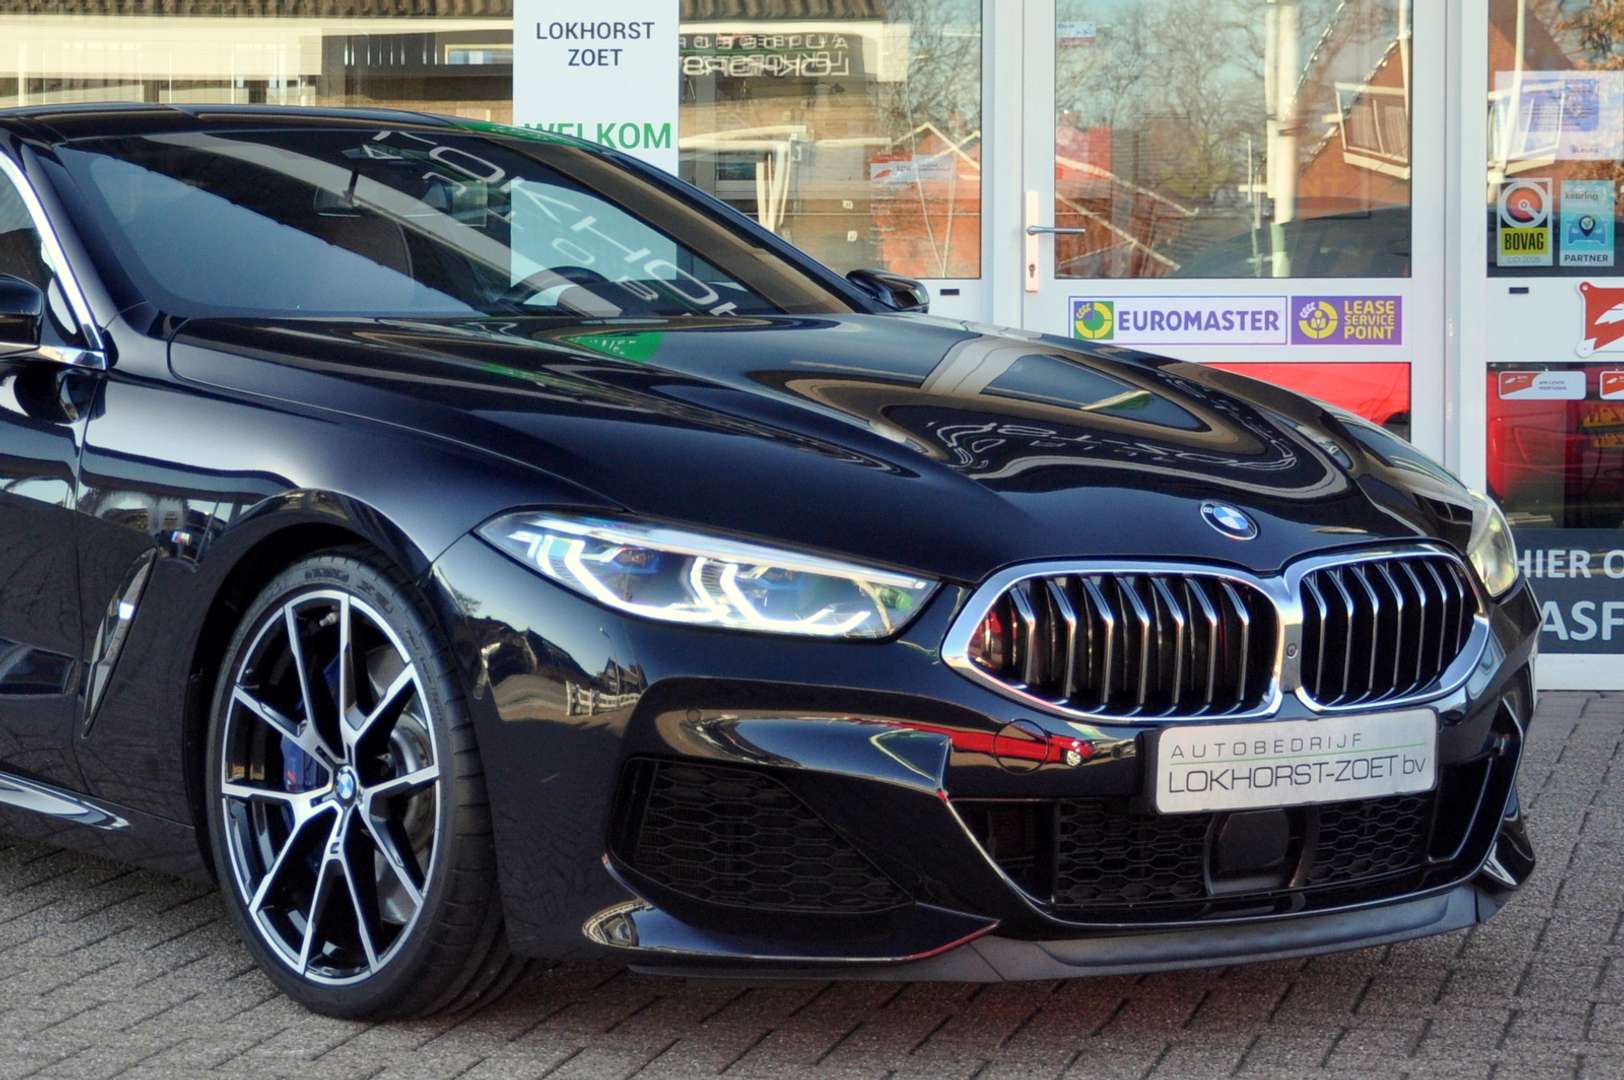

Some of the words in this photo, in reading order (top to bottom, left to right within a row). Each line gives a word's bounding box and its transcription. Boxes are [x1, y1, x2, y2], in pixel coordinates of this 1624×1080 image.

[535, 21, 656, 40] LOKHORST
[567, 48, 623, 67] ZOET
[523, 122, 671, 149] KOM
[1504, 232, 1545, 251] BOVAG
[1564, 254, 1609, 263] PARTNER
[1344, 300, 1395, 314] LEASE
[1118, 310, 1279, 331] EUROMASTER
[1344, 314, 1395, 326] SERVICE
[1344, 326, 1394, 339] POINT
[1518, 550, 1592, 578] HIER
[1171, 733, 1362, 760] AUTOBEDRIJF
[1169, 755, 1399, 793] LOKHORST-ZOET
[1402, 755, 1427, 776] bv
